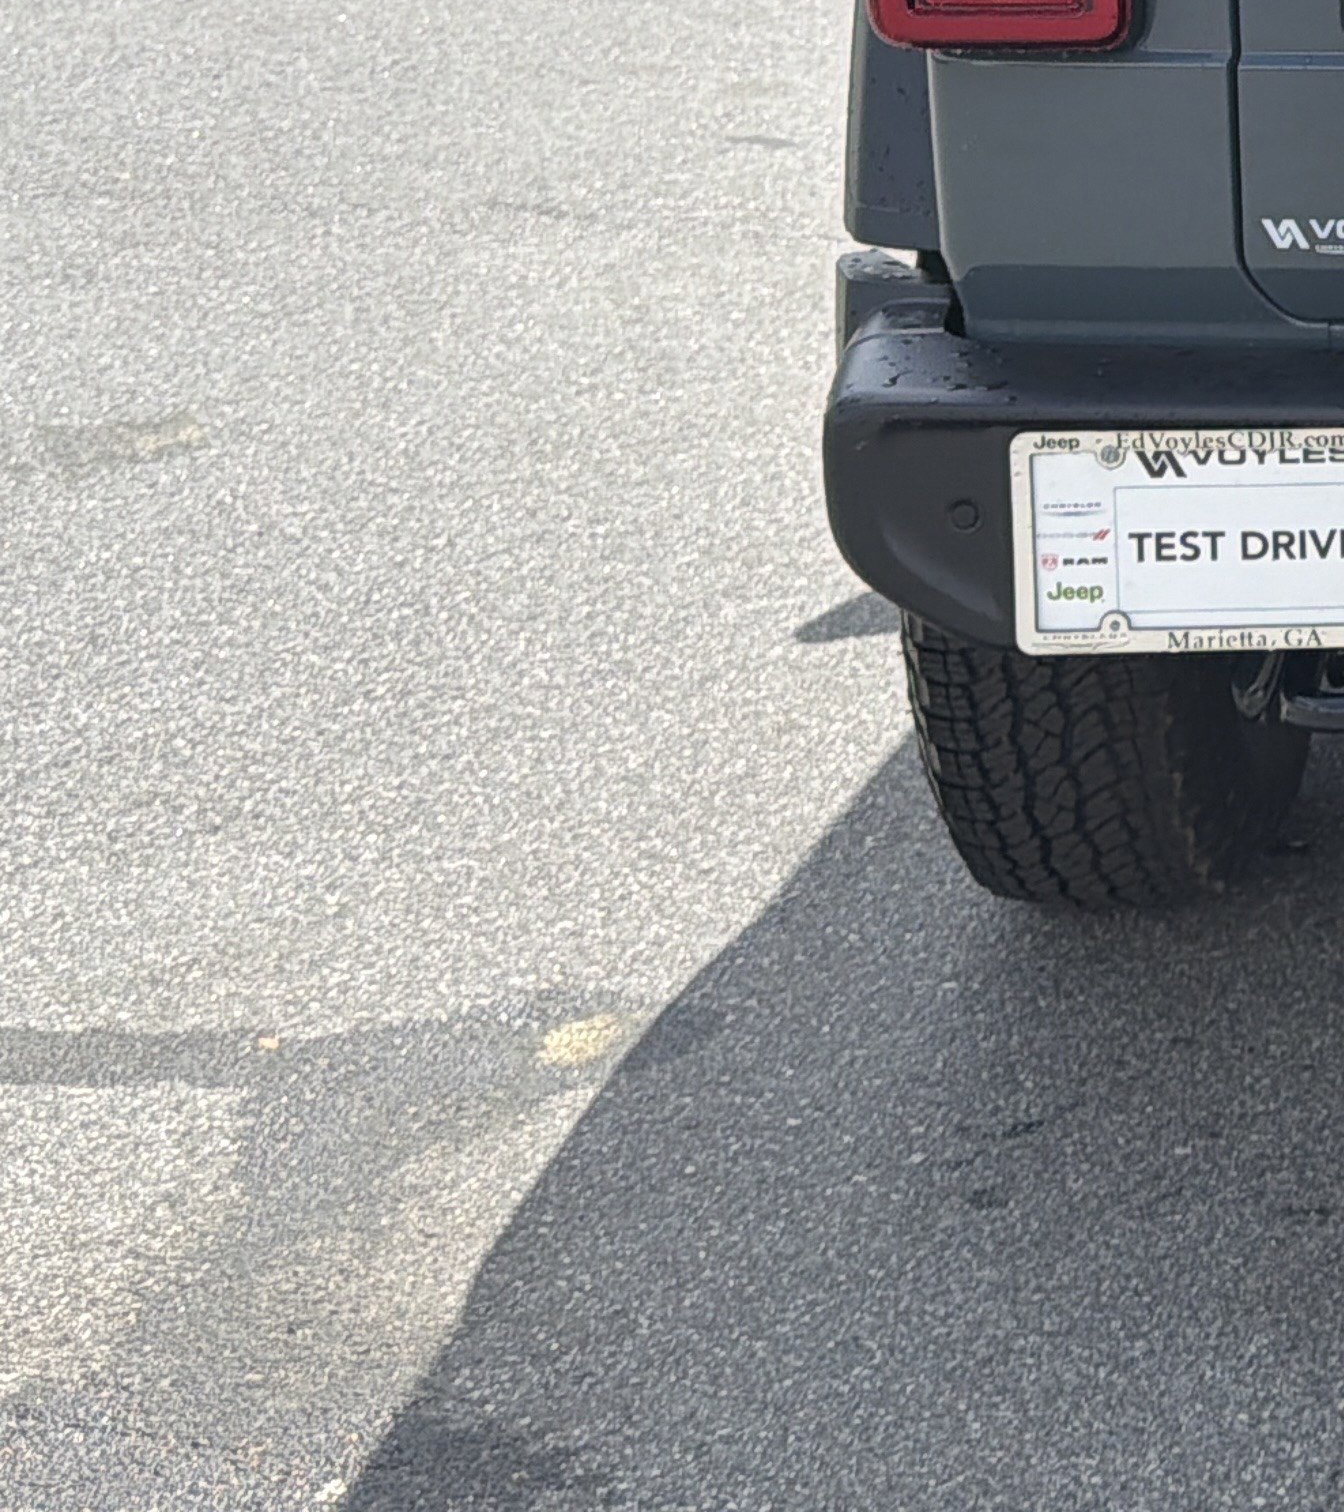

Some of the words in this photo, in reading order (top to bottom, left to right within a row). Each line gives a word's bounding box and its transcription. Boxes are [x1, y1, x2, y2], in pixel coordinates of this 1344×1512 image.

[1033, 435, 1081, 451] Jeep
[1128, 530, 1226, 563] TEST
[1062, 556, 1109, 567] RAM
[1046, 581, 1104, 603] Jeep
[1166, 626, 1277, 650] Marietta,
[1284, 627, 1324, 649] GA
